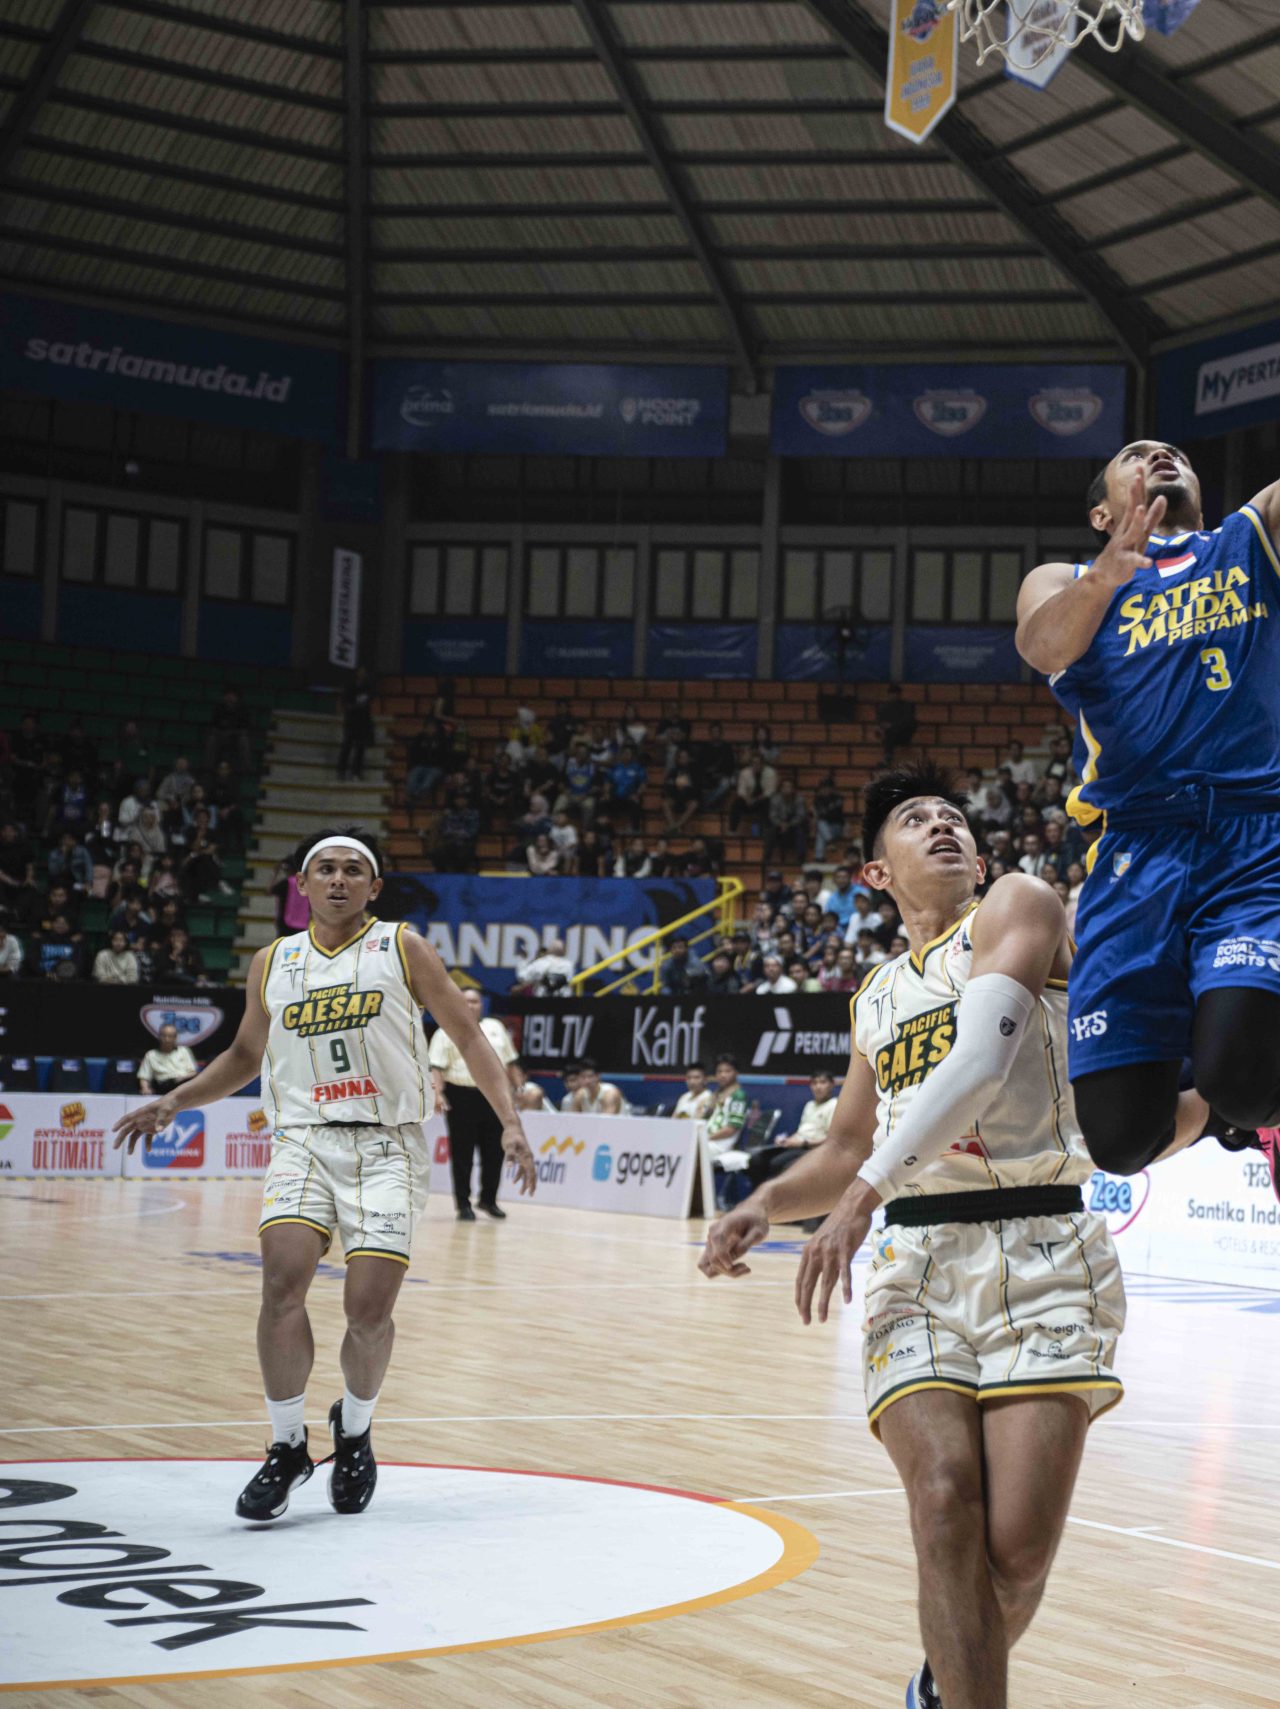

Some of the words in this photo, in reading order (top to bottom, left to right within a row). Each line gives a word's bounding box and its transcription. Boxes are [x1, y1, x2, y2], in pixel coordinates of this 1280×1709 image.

[24, 336, 293, 404] satriamuda.id
[641, 411, 695, 425] POINT
[1118, 565, 1250, 635] SATRIA
[1123, 590, 1244, 657] MUDA
[1201, 646, 1233, 692] 3
[408, 922, 665, 971] ANDUNG
[1213, 953, 1266, 968] SPORTS
[1216, 943, 1257, 957] ROYAL
[284, 992, 383, 1029] CAESAR
[310, 985, 349, 1001] PACIFIC
[300, 1016, 368, 1036] SURABAYA
[632, 1005, 706, 1067] Kahf
[902, 1007, 951, 1038] PACIFIC
[330, 1038, 352, 1074] 9
[877, 1024, 954, 1090] CAES
[313, 1079, 379, 1103] FINNA
[33, 1140, 104, 1170] ULTIMATE
[616, 1149, 683, 1188] gopay
[1090, 1172, 1132, 1214] Zee
[1187, 1198, 1245, 1223] Santika
